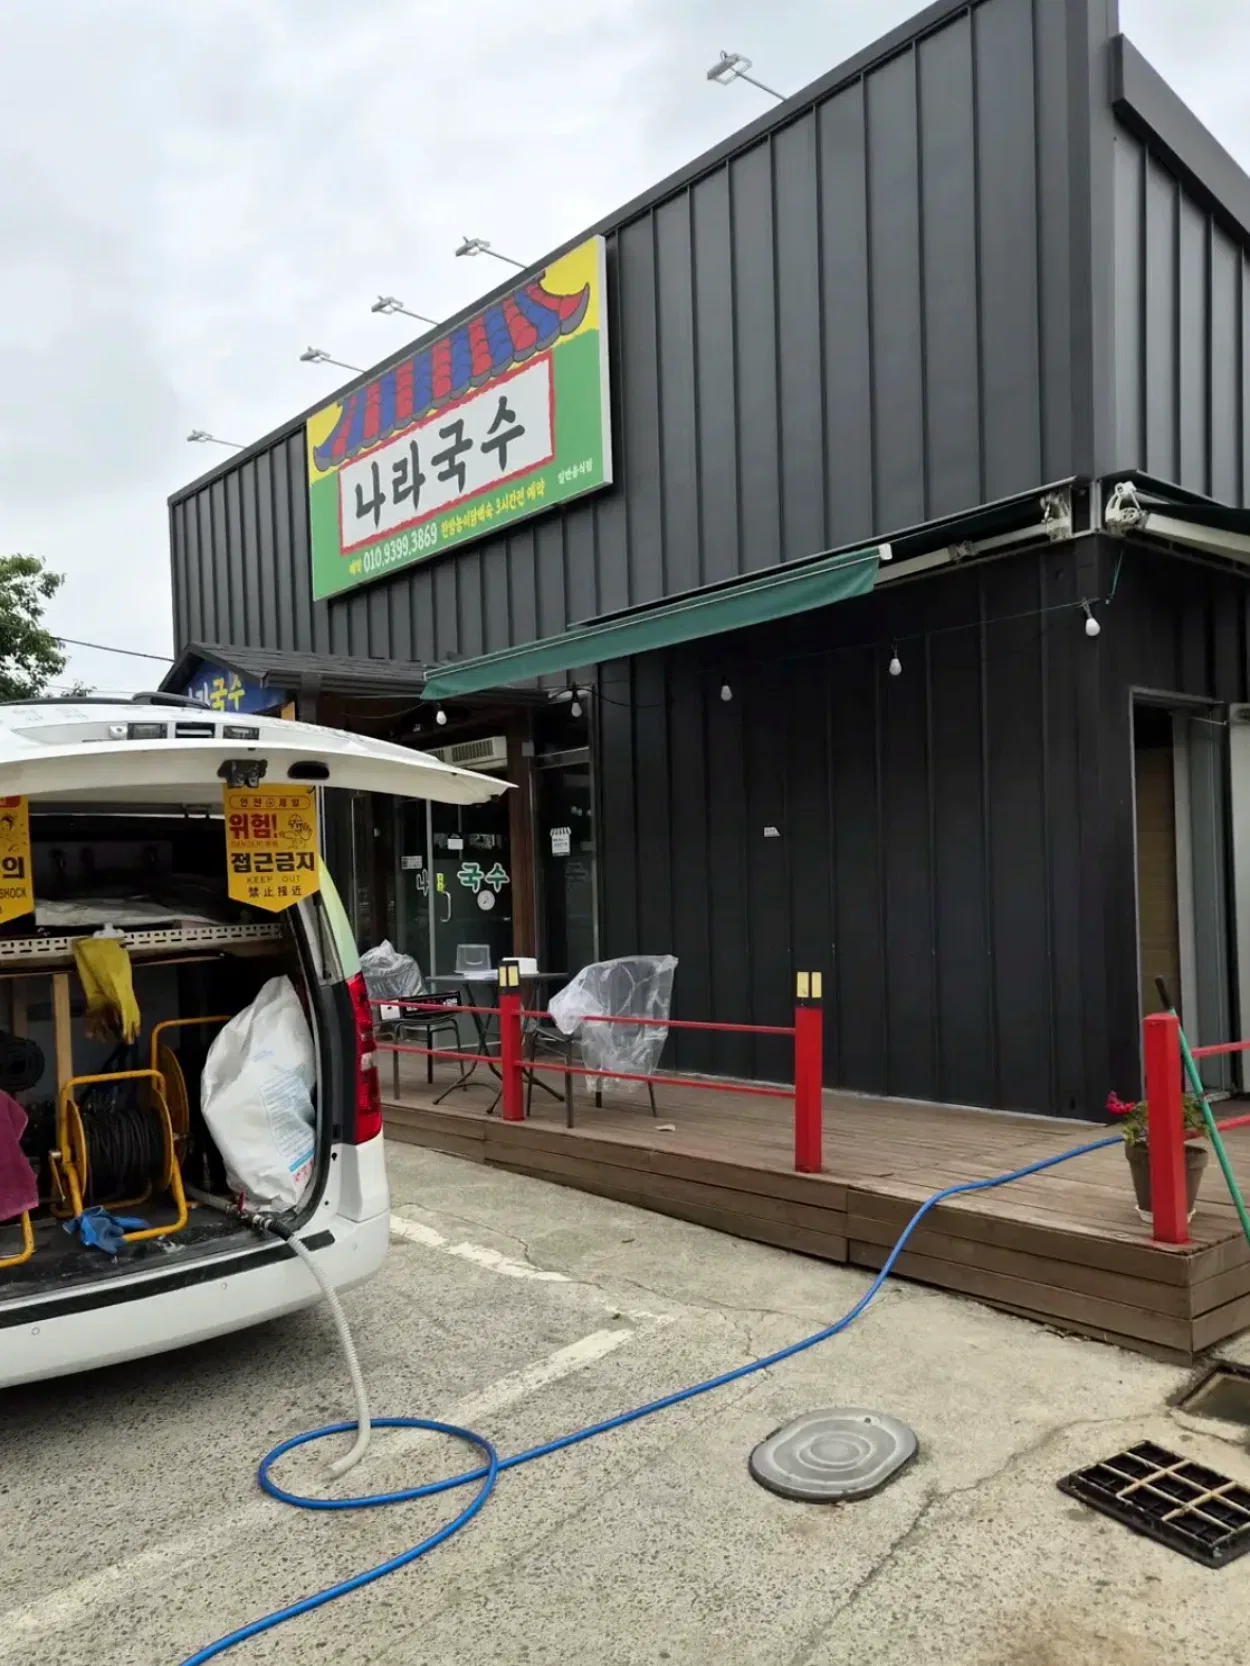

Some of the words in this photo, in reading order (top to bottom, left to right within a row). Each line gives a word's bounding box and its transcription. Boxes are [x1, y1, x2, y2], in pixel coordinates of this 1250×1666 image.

[355, 395, 526, 528] 나라국수
[363, 522, 438, 574] 010.9399.3869
[229, 813, 278, 839] 위험!
[2, 856, 25, 879] 의
[231, 851, 315, 873] 접근금지
[246, 875, 273, 884] KEEP
[281, 874, 301, 883] OUT
[457, 862, 510, 893] 국수
